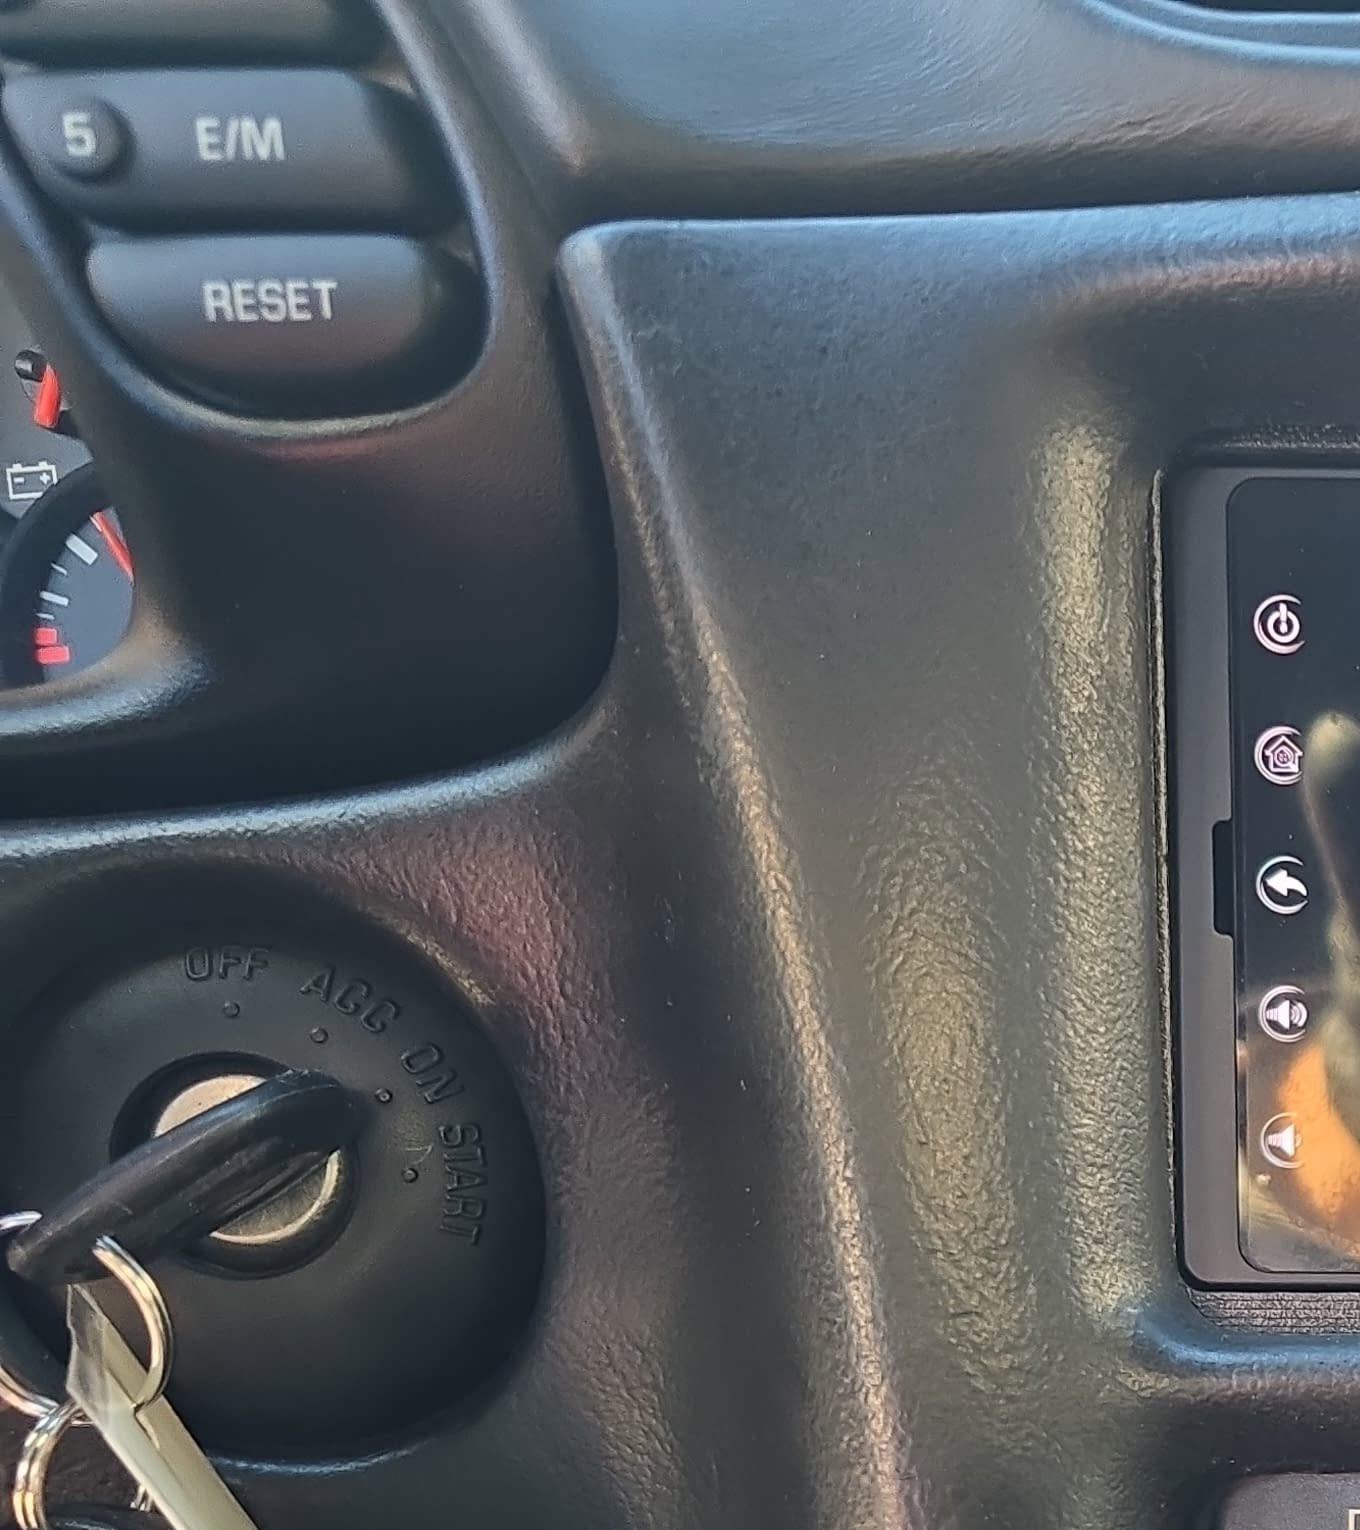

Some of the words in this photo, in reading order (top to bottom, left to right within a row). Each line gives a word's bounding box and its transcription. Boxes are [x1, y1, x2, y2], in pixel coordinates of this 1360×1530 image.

[62, 112, 98, 157] 5
[195, 117, 286, 161] E/M
[203, 280, 337, 322] RESET
[184, 946, 270, 982] OFF
[299, 964, 399, 1034] ACC
[400, 1042, 464, 1104] ON
[437, 1123, 487, 1247] START
